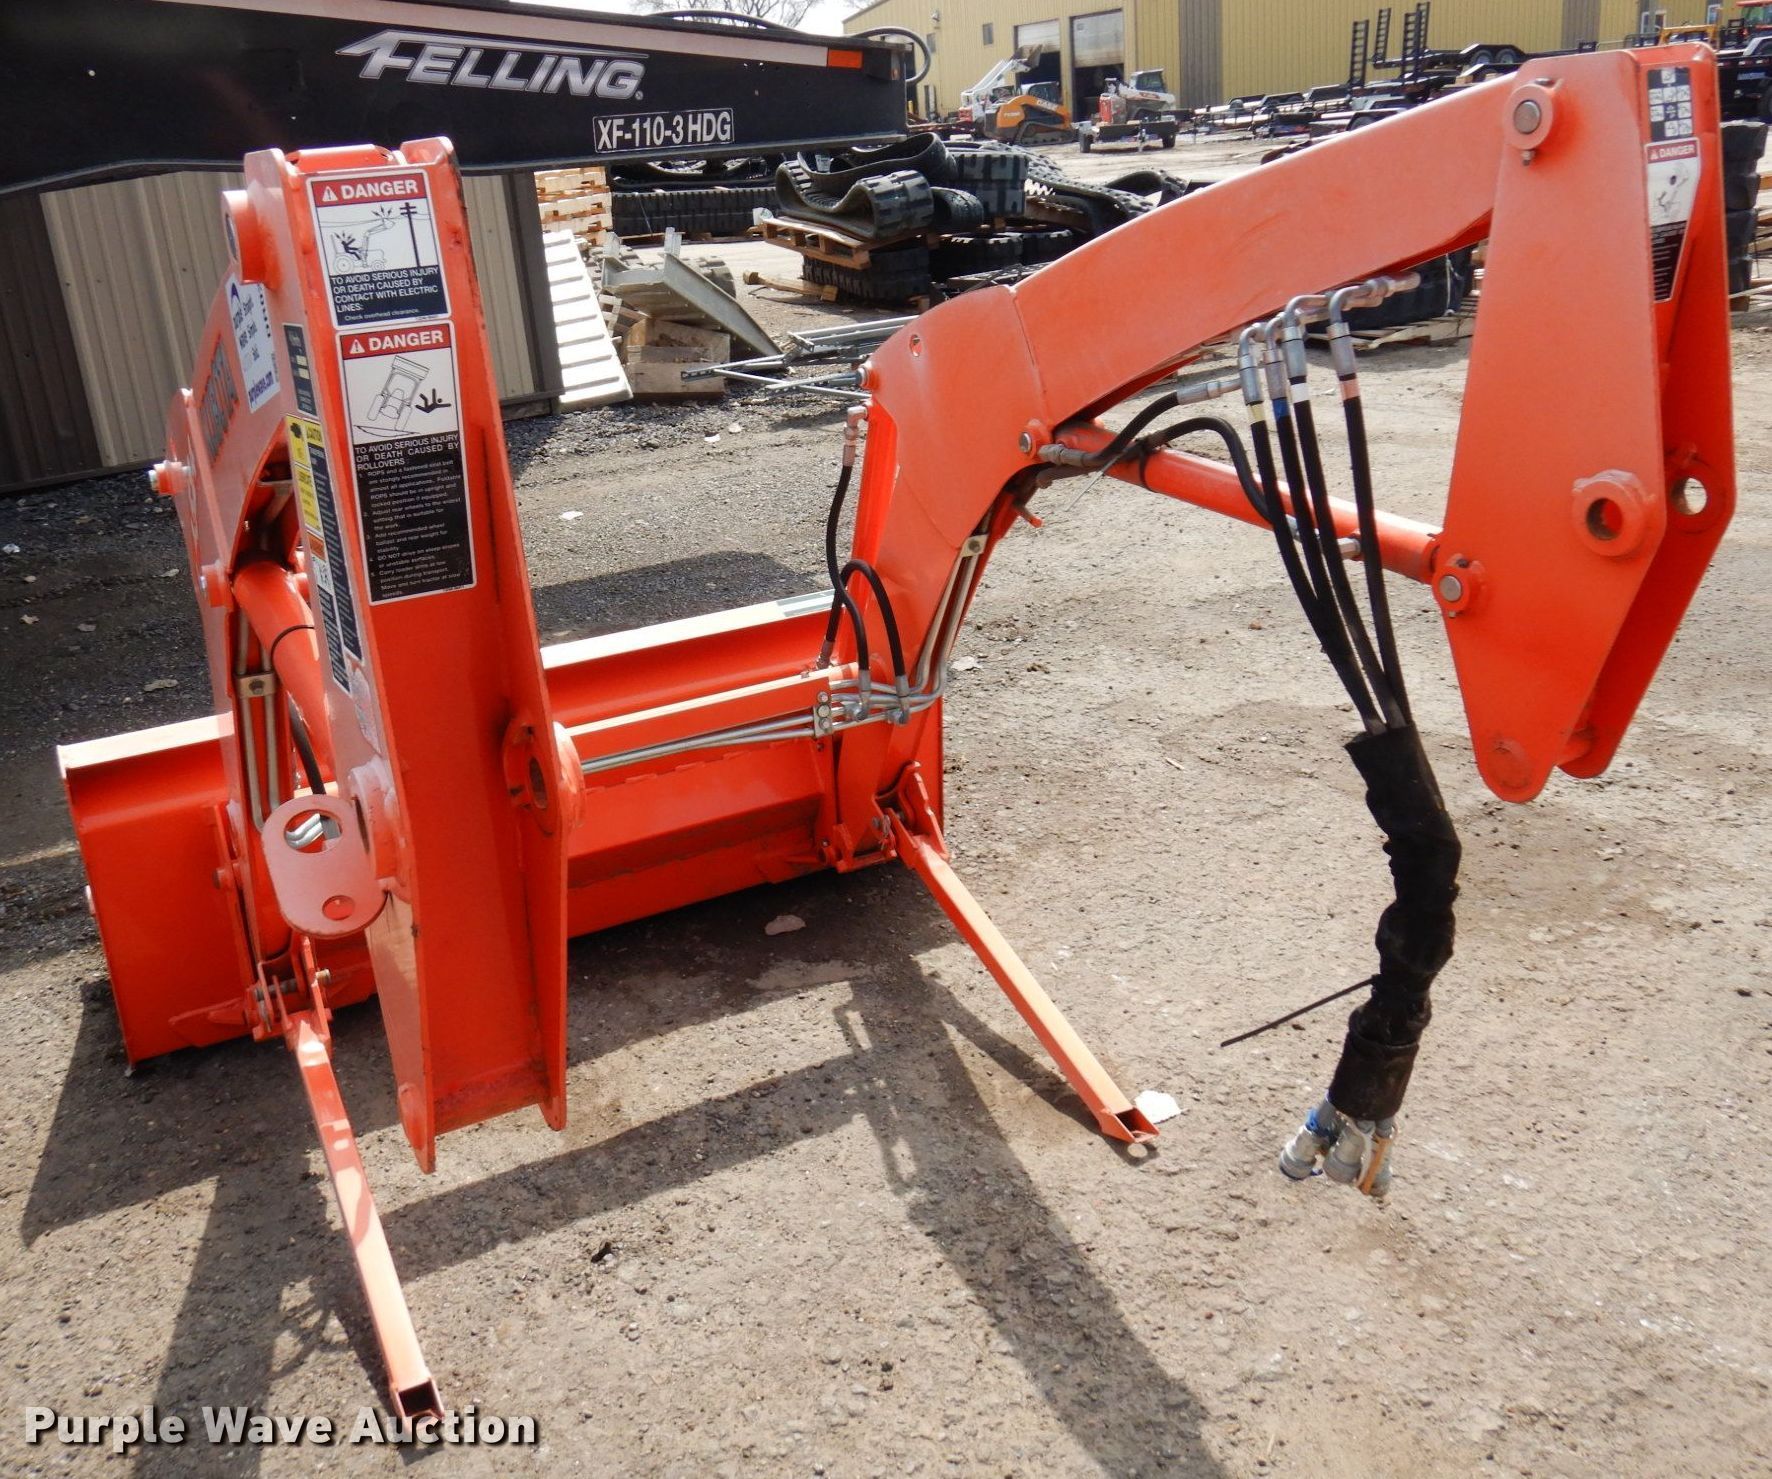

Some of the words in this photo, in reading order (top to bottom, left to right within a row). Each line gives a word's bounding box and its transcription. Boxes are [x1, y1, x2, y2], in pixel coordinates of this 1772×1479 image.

[336, 30, 647, 99] FELLING
[597, 115, 683, 150] XF-110-3
[688, 112, 732, 143] HDG
[340, 179, 419, 200] DANGER
[344, 274, 370, 283] AVOID
[371, 270, 408, 280] SERIOUS
[409, 267, 439, 276] INJURY
[334, 293, 374, 302] CONTACT
[375, 290, 397, 298] WITH
[398, 285, 438, 295] ELECTRIC
[347, 283, 375, 292] DEATH
[376, 279, 410, 288] CAUSED
[368, 330, 444, 351] DANGER
[368, 443, 392, 452] AVOID
[394, 437, 428, 448] SERIOUS
[430, 433, 458, 443] INJURY
[374, 449, 402, 460] DEATH
[407, 444, 443, 455] CAUSED
